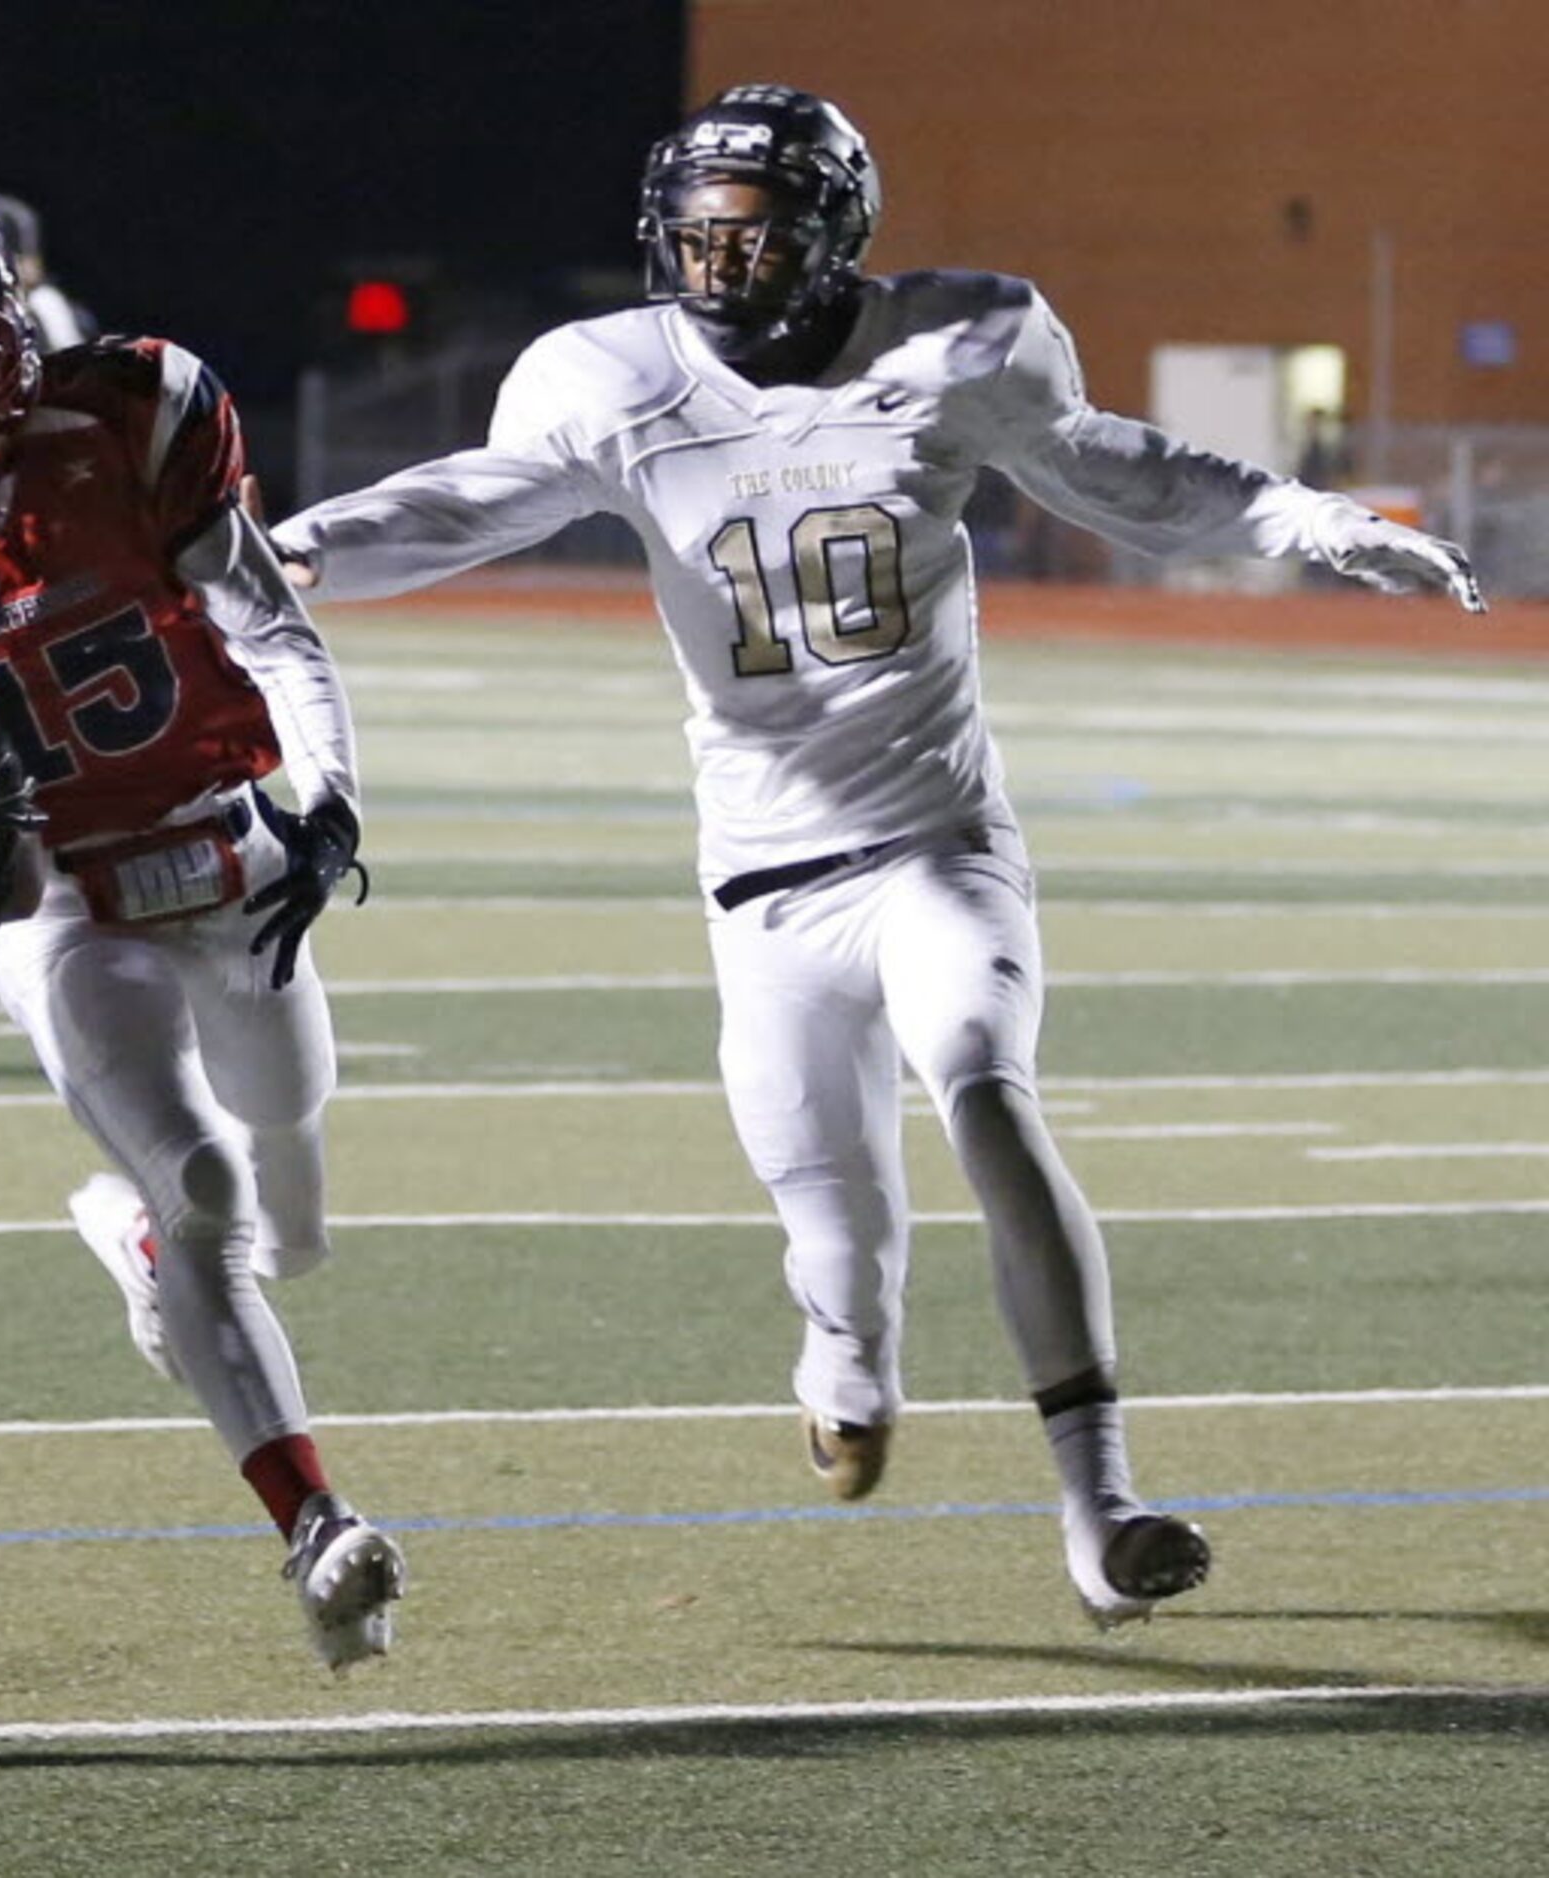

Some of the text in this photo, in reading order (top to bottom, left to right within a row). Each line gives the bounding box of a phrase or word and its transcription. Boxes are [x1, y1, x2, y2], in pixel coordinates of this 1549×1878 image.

[730, 460, 858, 498] THE COLONY
[708, 502, 911, 677] 10
